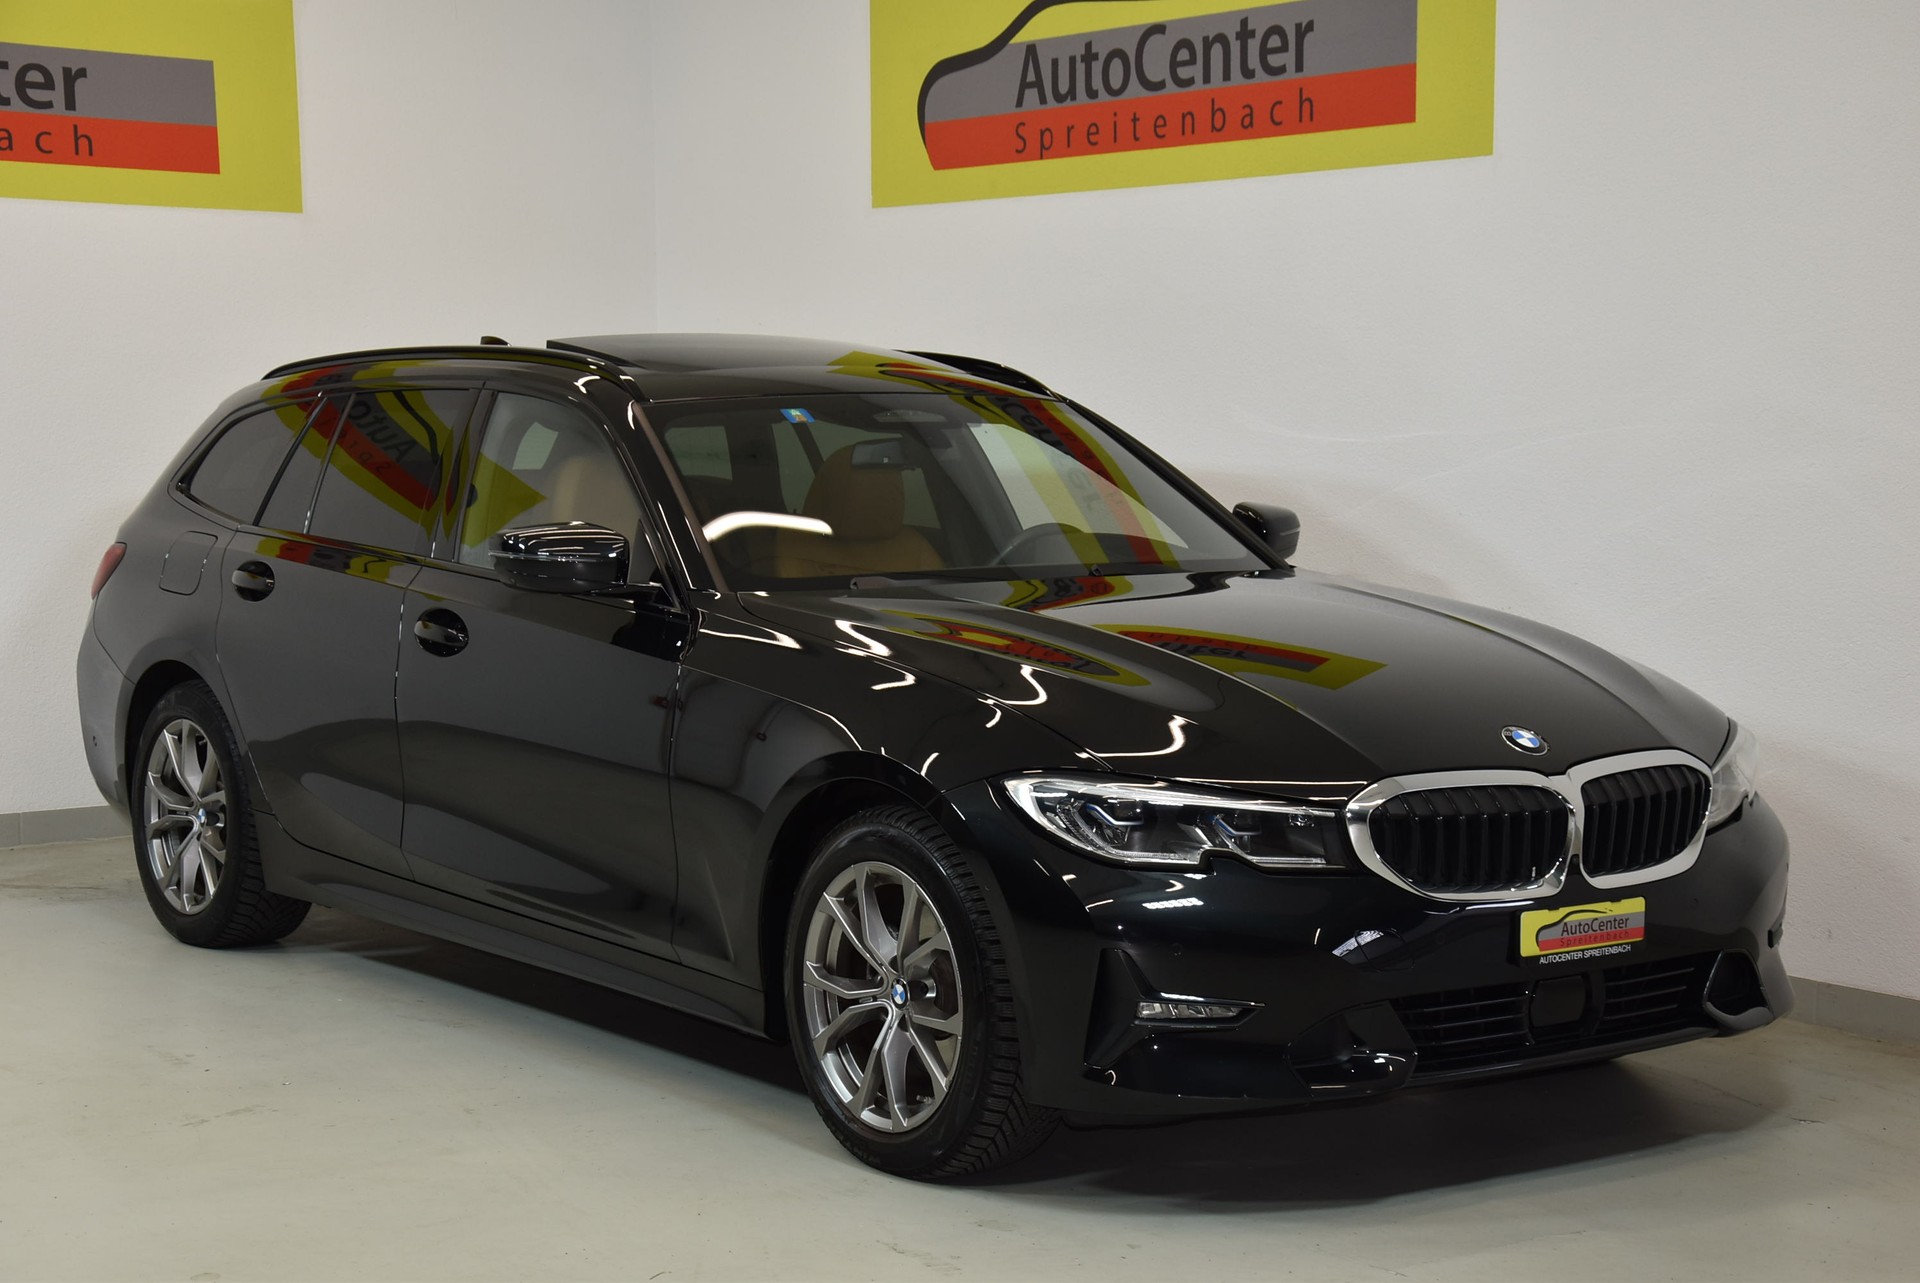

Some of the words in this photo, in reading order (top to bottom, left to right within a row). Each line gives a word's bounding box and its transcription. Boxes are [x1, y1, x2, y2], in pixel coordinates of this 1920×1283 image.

[1014, 17, 1315, 108] AutoCenter
[1015, 87, 1314, 160] Spreitenbach
[1560, 916, 1630, 936] AutoCenter
[1559, 930, 1630, 948] Spreitenbach
[1539, 952, 1583, 965] AUTOCENTER
[1583, 944, 1632, 959] SPREITENBACH
